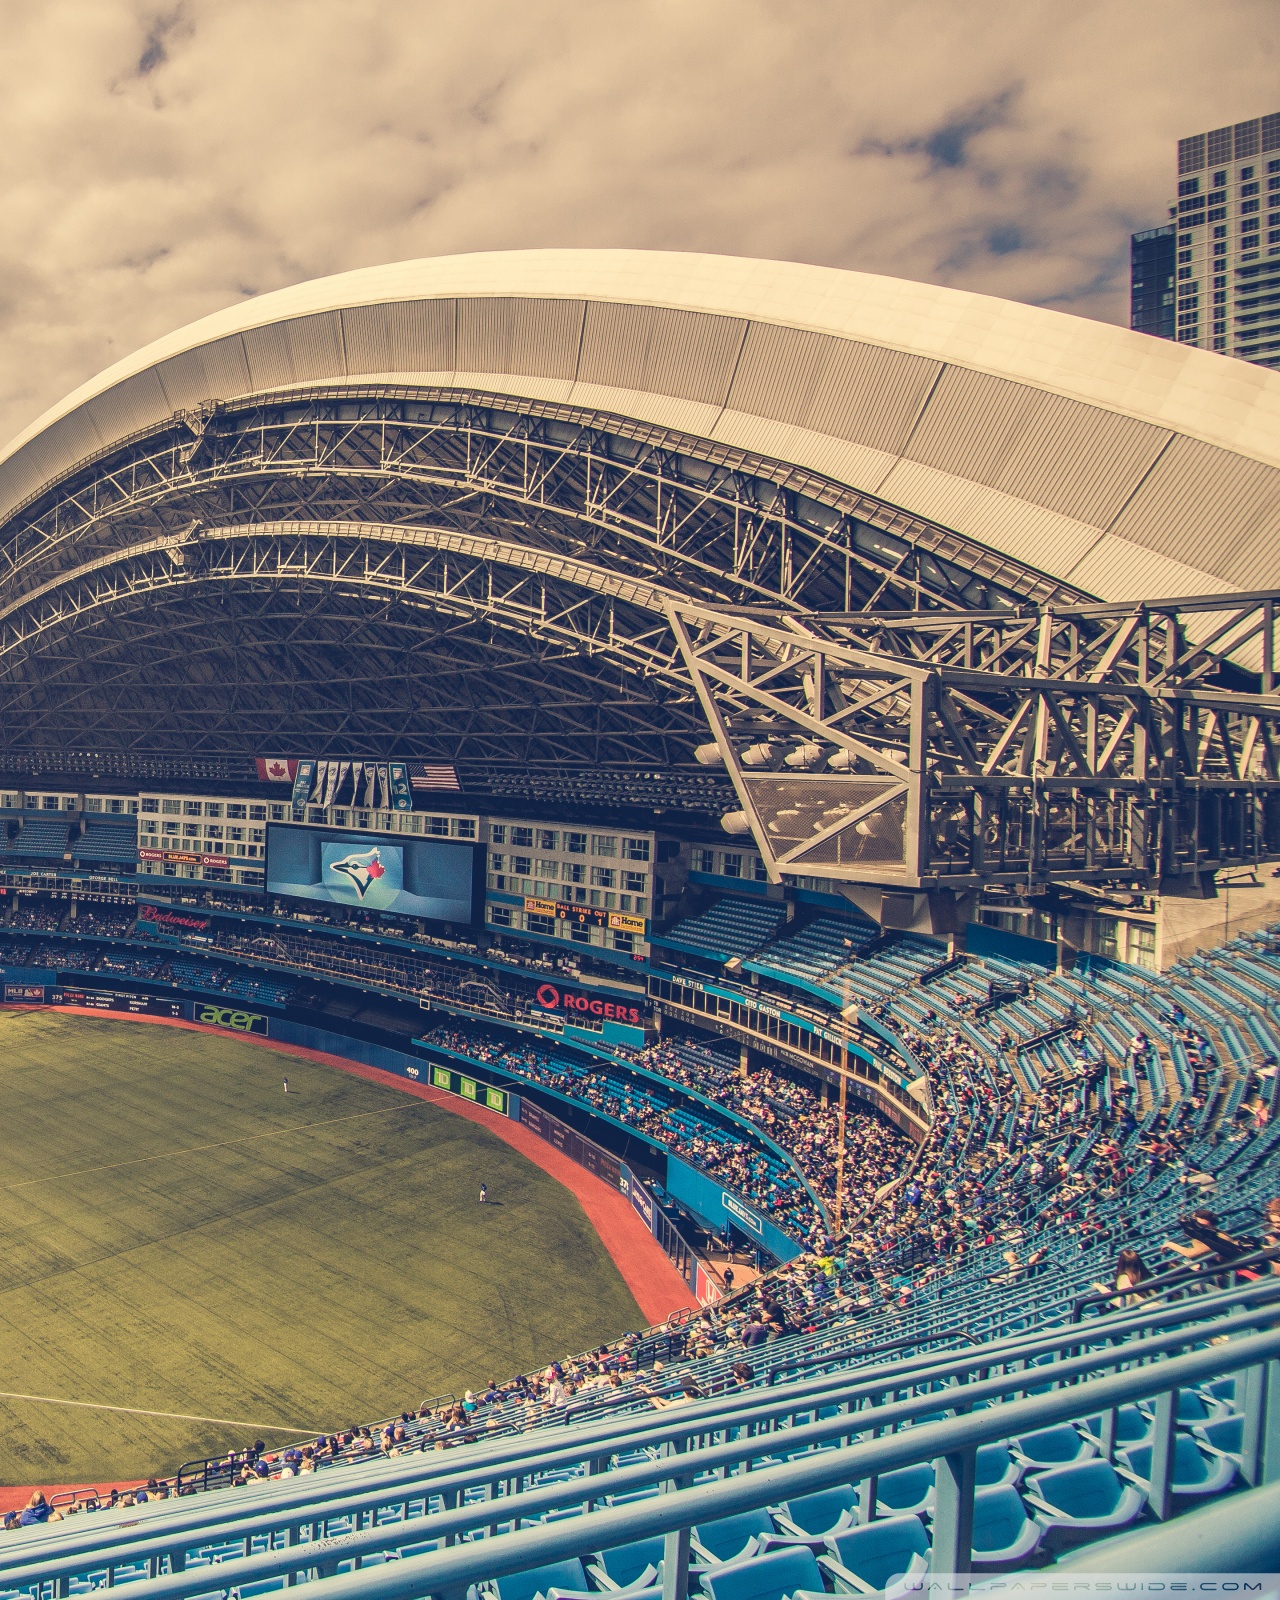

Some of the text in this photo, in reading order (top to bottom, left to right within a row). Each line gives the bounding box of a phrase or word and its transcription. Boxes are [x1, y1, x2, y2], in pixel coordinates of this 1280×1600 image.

[535, 900, 555, 911] Home
[556, 903, 570, 911] BALL
[571, 906, 592, 915] STRIKE
[140, 905, 208, 929] Budweiser
[620, 916, 644, 928] Home
[672, 975, 704, 991] DAVE STIEB
[564, 993, 640, 1023] ROGERS
[744, 998, 781, 1018] CITO GASTON
[200, 1005, 261, 1031] acer
[823, 1030, 843, 1047] GILLICK
[406, 1066, 419, 1076] 400
